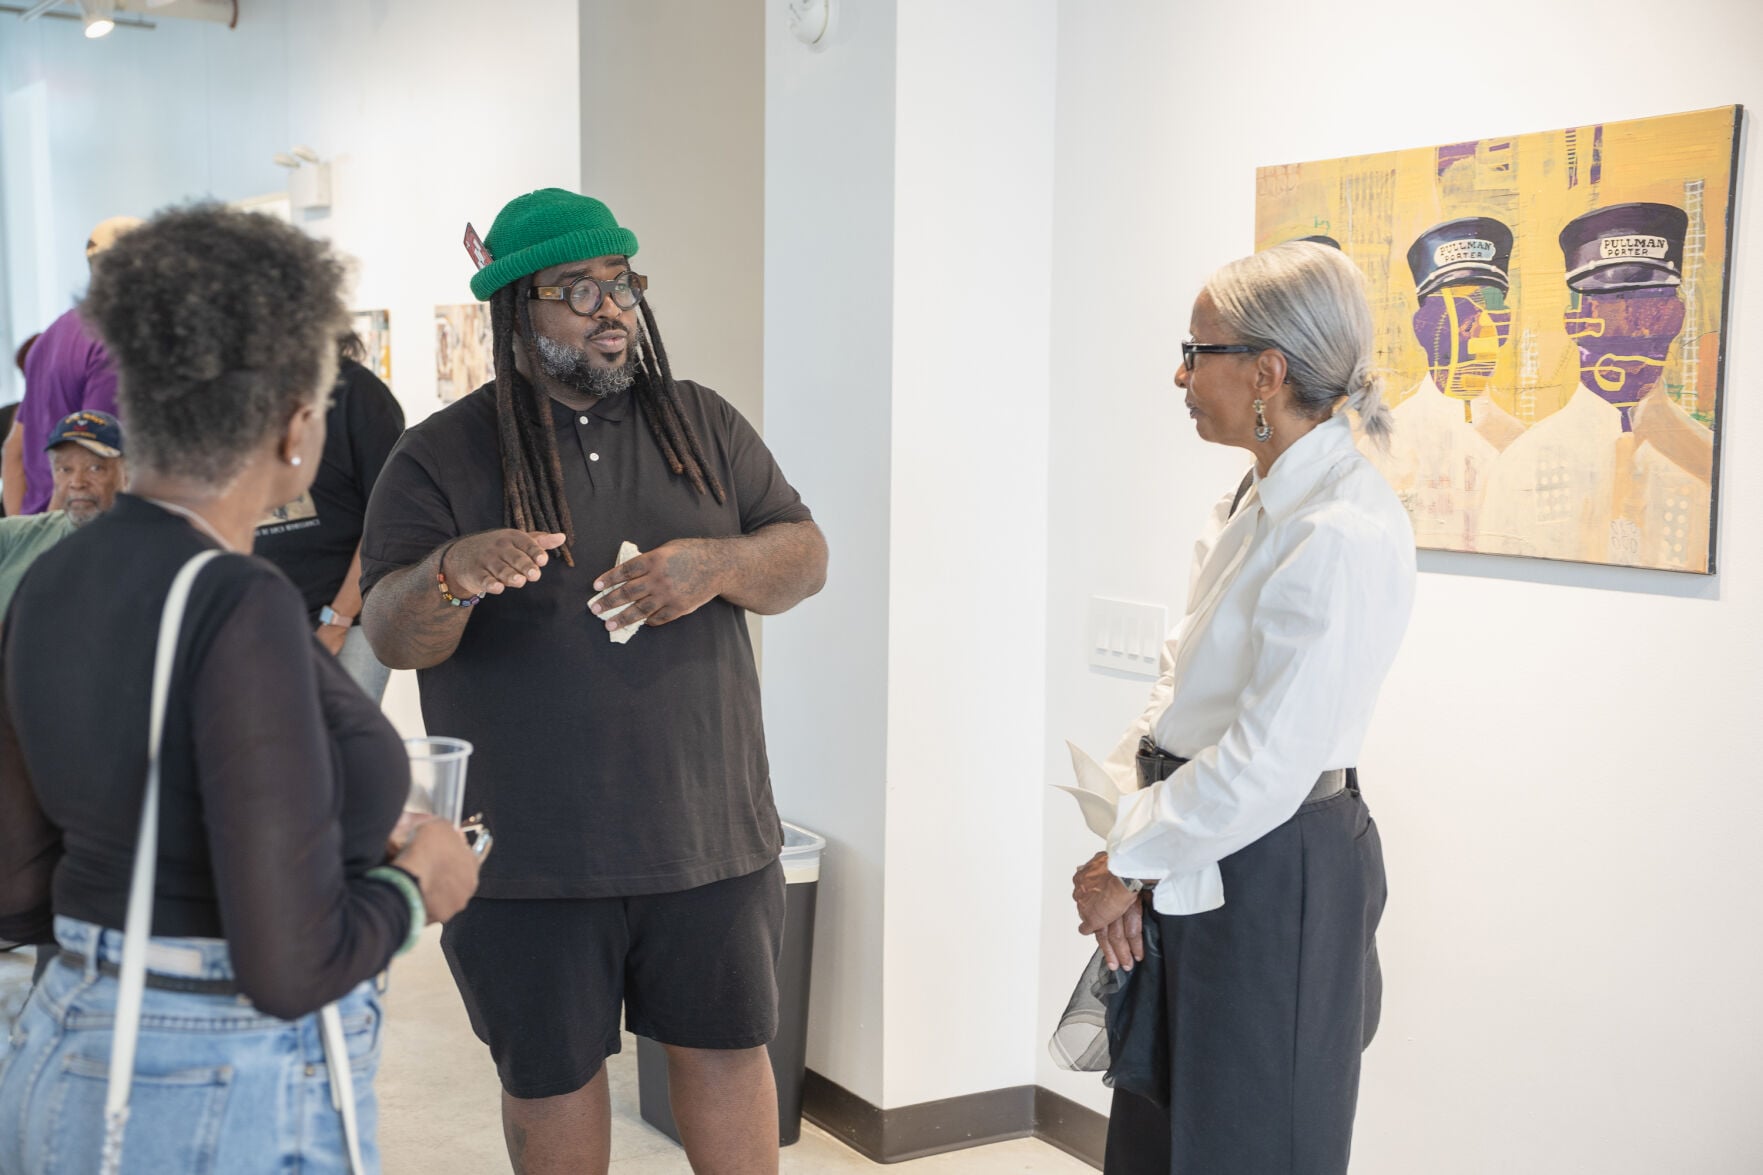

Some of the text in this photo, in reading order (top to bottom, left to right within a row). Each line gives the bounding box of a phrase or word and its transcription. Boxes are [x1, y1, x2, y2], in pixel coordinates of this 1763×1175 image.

[1440, 241, 1491, 256] PULLMAN
[1604, 238, 1666, 250] PULLMAN
[1444, 252, 1482, 262] PORTER
[1607, 248, 1649, 256] PORTER
